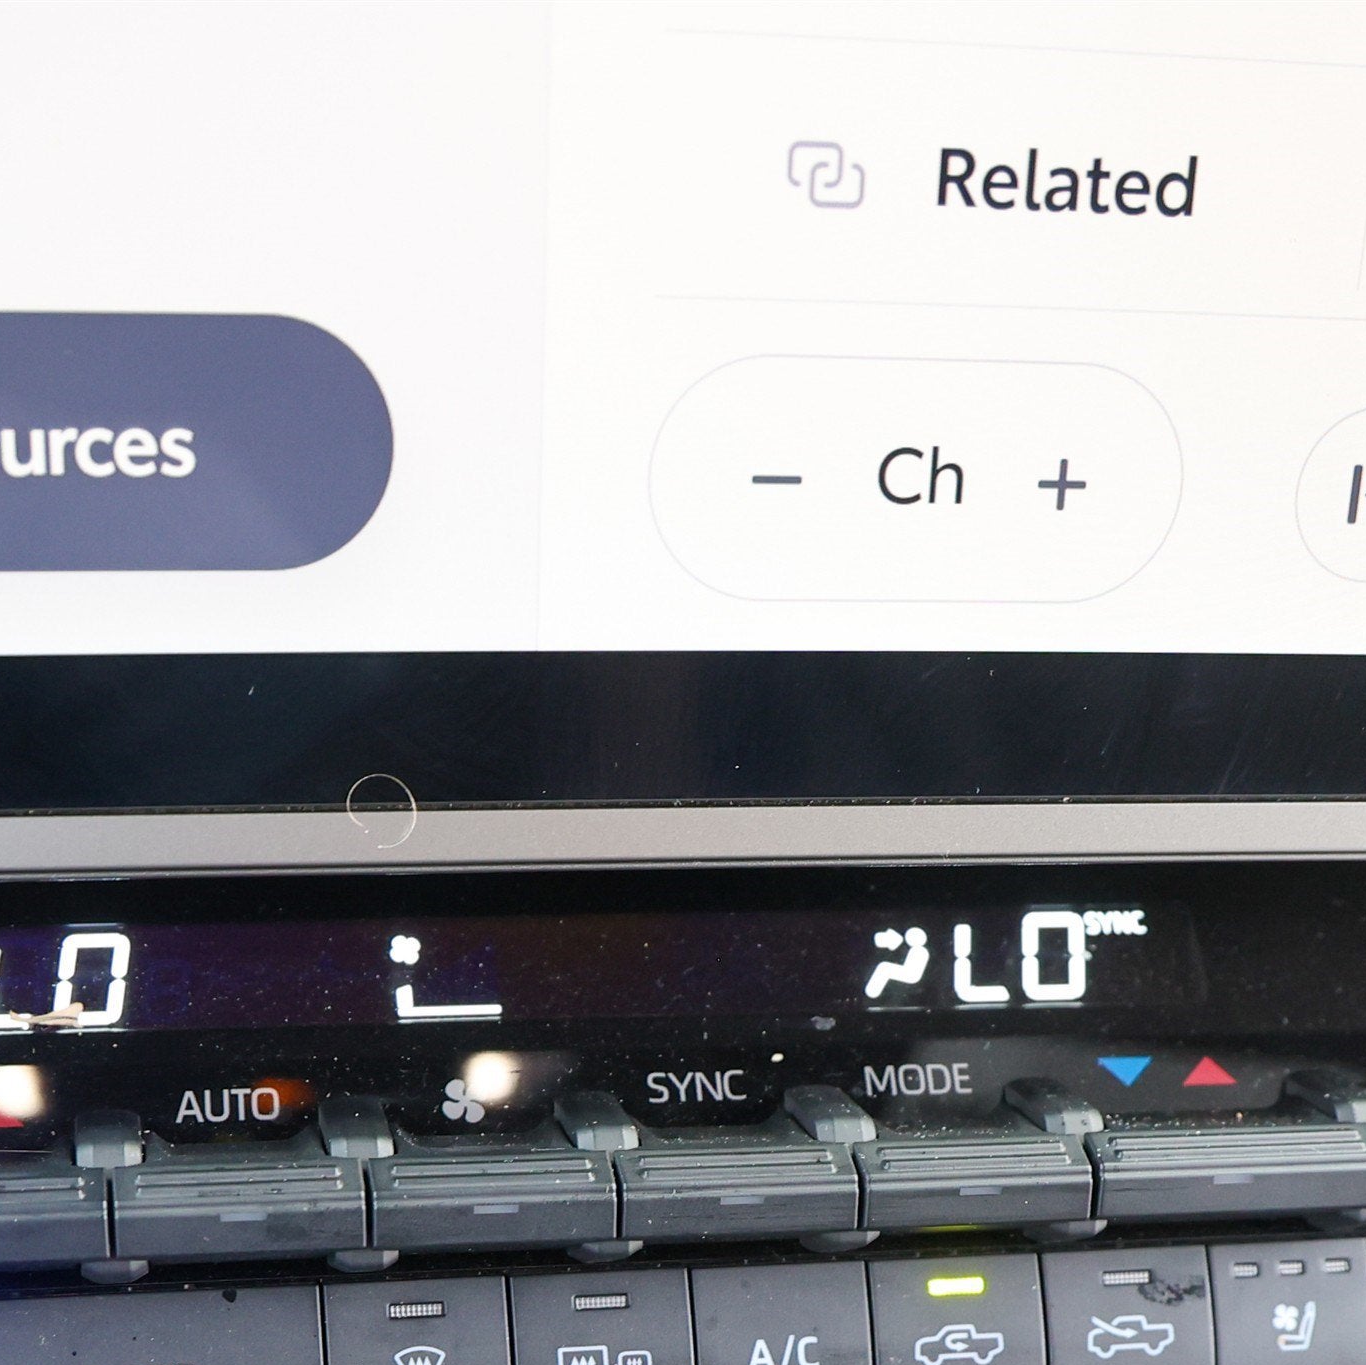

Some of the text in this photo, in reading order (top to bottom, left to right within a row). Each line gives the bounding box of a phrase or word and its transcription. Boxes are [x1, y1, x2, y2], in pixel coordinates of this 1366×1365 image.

[937, 147, 1199, 219] Related
[877, 445, 964, 505] Ch
[1082, 910, 1148, 937] SYNC
[646, 1069, 747, 1104] SYNC
[863, 1062, 973, 1097] MODE
[175, 1086, 281, 1125] AUTO
